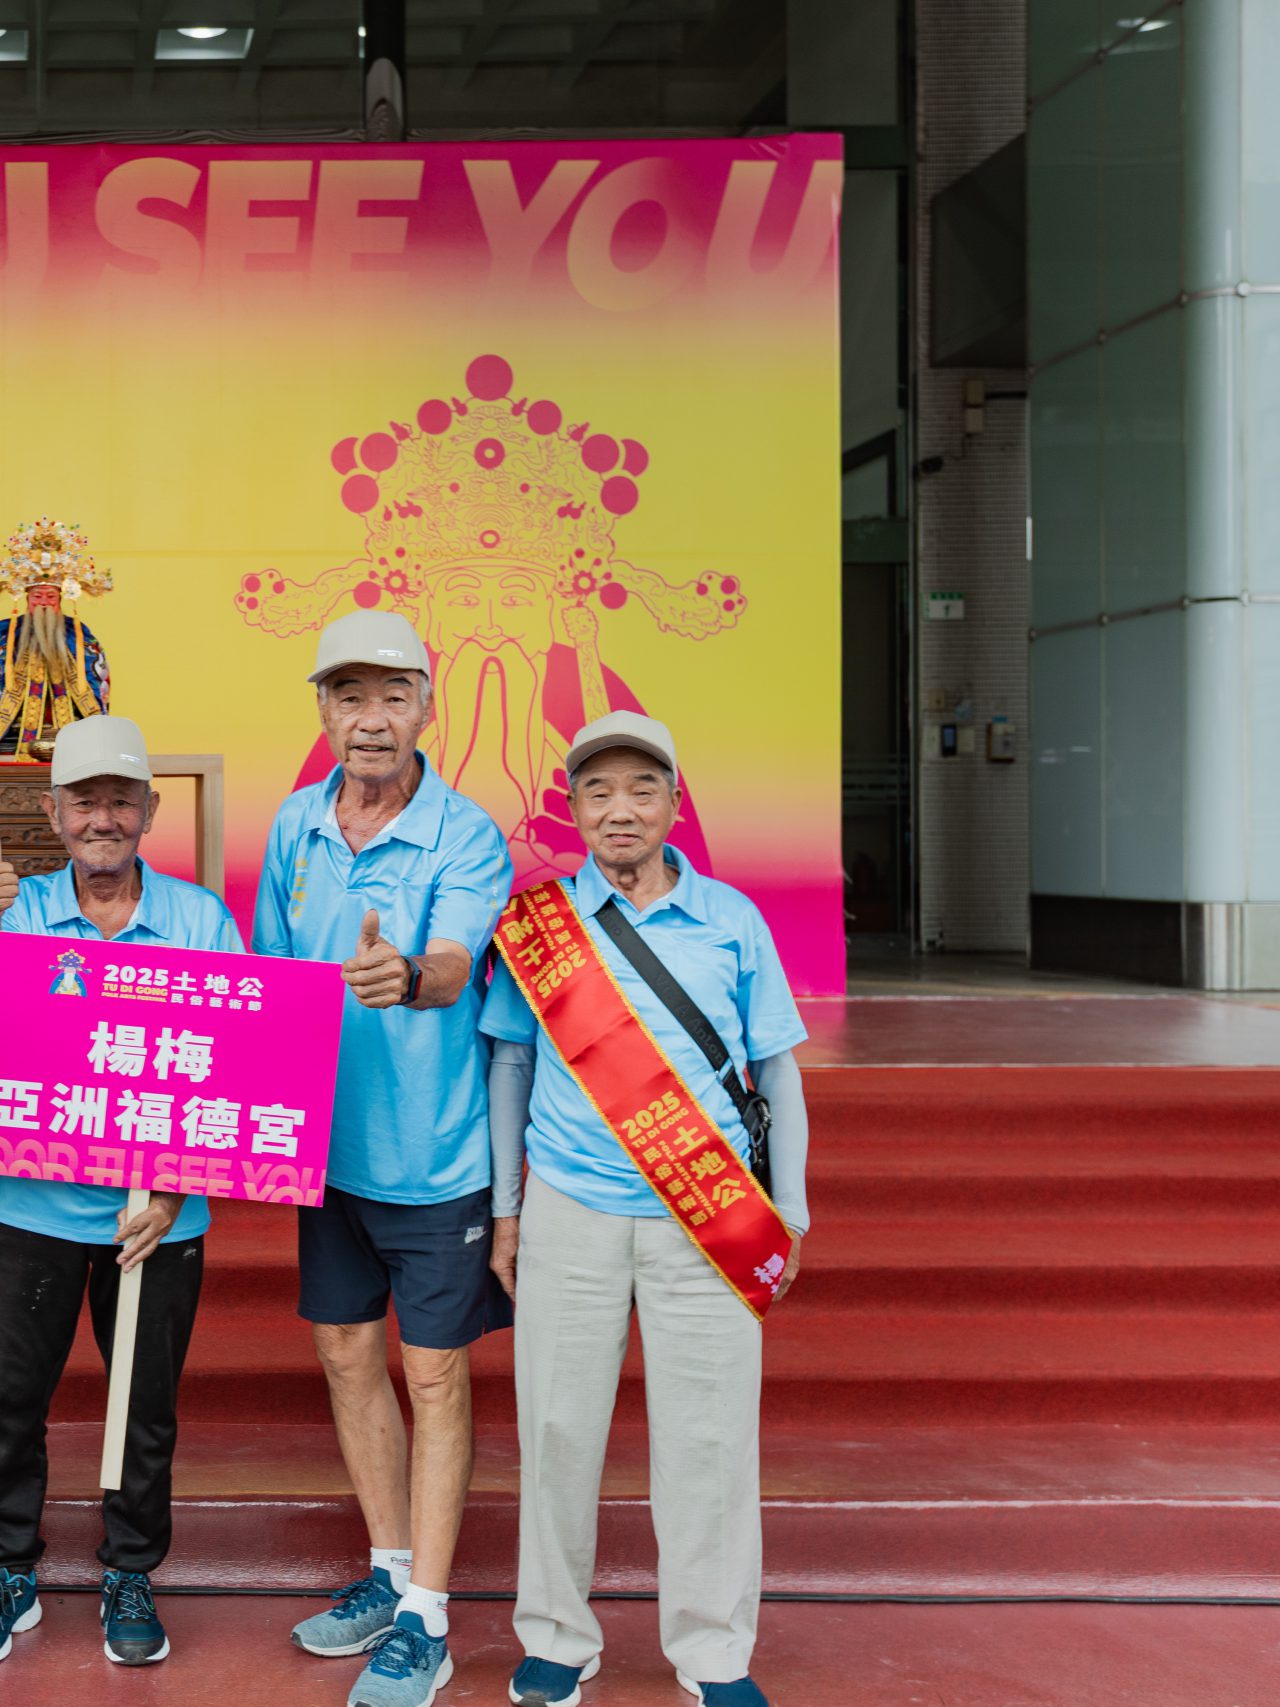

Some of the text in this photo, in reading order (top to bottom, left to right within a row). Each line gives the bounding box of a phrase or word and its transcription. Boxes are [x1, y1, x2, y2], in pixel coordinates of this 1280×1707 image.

[95, 157, 424, 308] SEE
[463, 156, 843, 312] YOU
[102, 982, 169, 997] TU DI GONG
[103, 964, 265, 998] 2025 土地公
[537, 948, 587, 1000] 2025
[170, 993, 263, 1012] 民俗藝術節
[86, 1020, 215, 1083] 楊梅
[621, 1090, 682, 1140] 2025
[631, 1106, 689, 1149] TU DI GONG
[153, 1152, 233, 1184] SEE
[658, 1139, 718, 1218] FOLK ARTS FESTIVAL
[673, 1124, 748, 1210] 土地公
